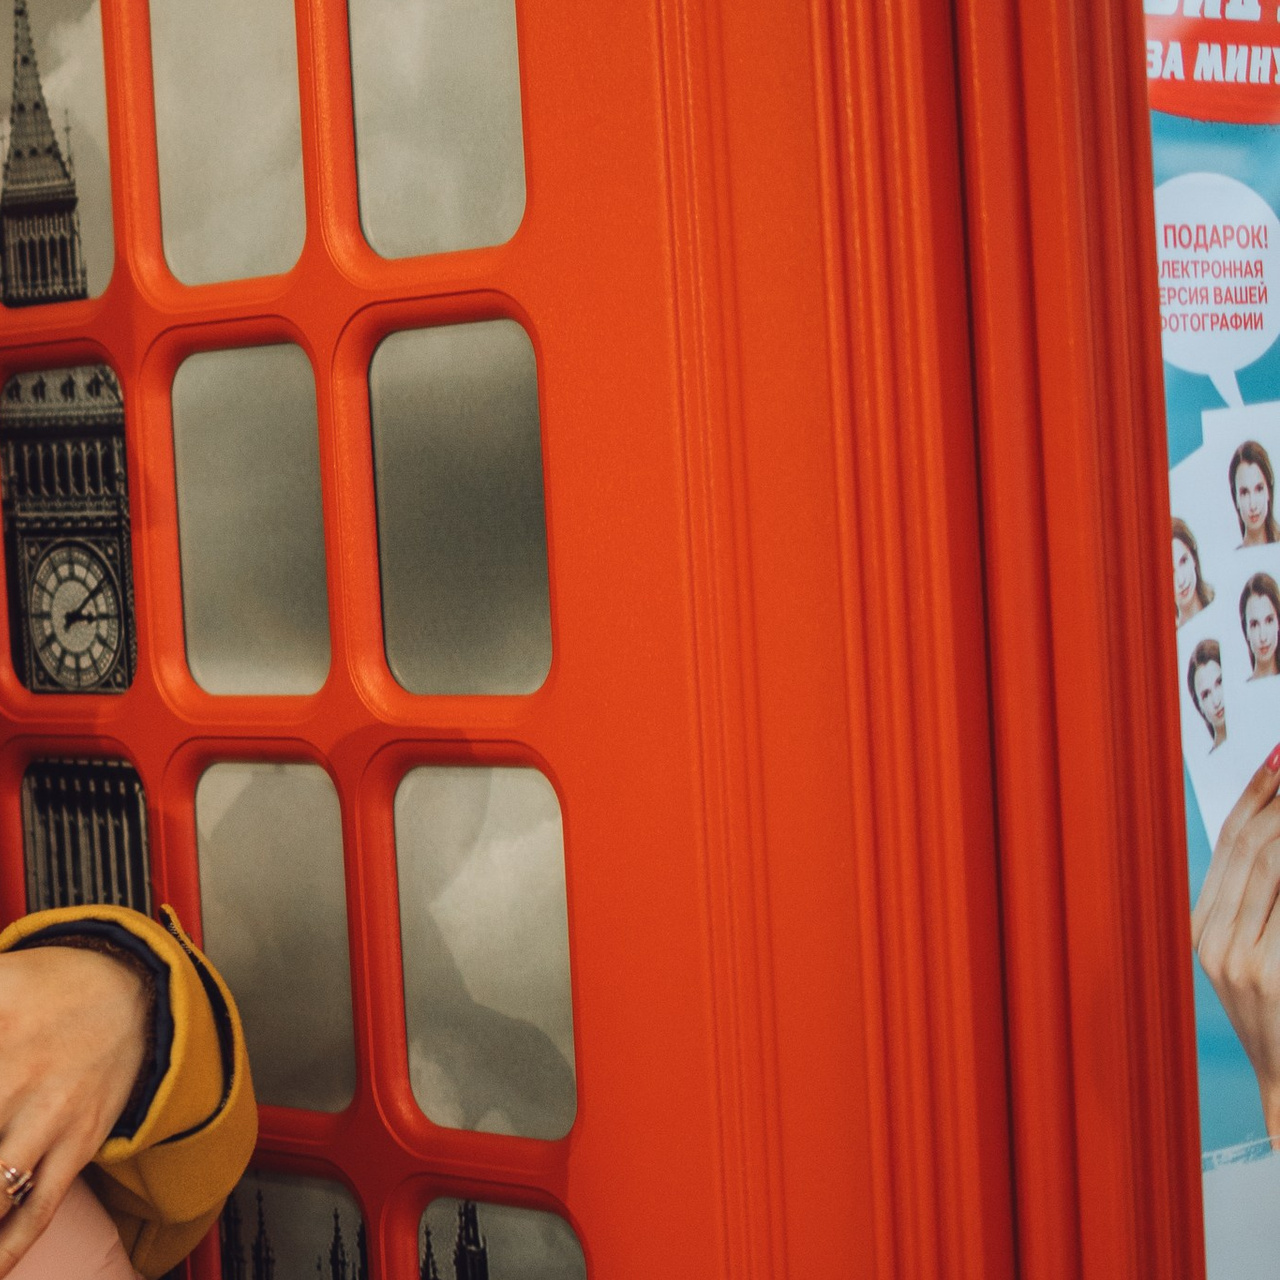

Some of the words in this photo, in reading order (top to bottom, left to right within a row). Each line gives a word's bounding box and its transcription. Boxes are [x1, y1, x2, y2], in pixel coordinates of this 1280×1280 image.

[1146, 40, 1185, 80] ЗА
[1163, 224, 1268, 253] ПОДАРОК!
[1213, 281, 1268, 305] ВАШЕЙ
